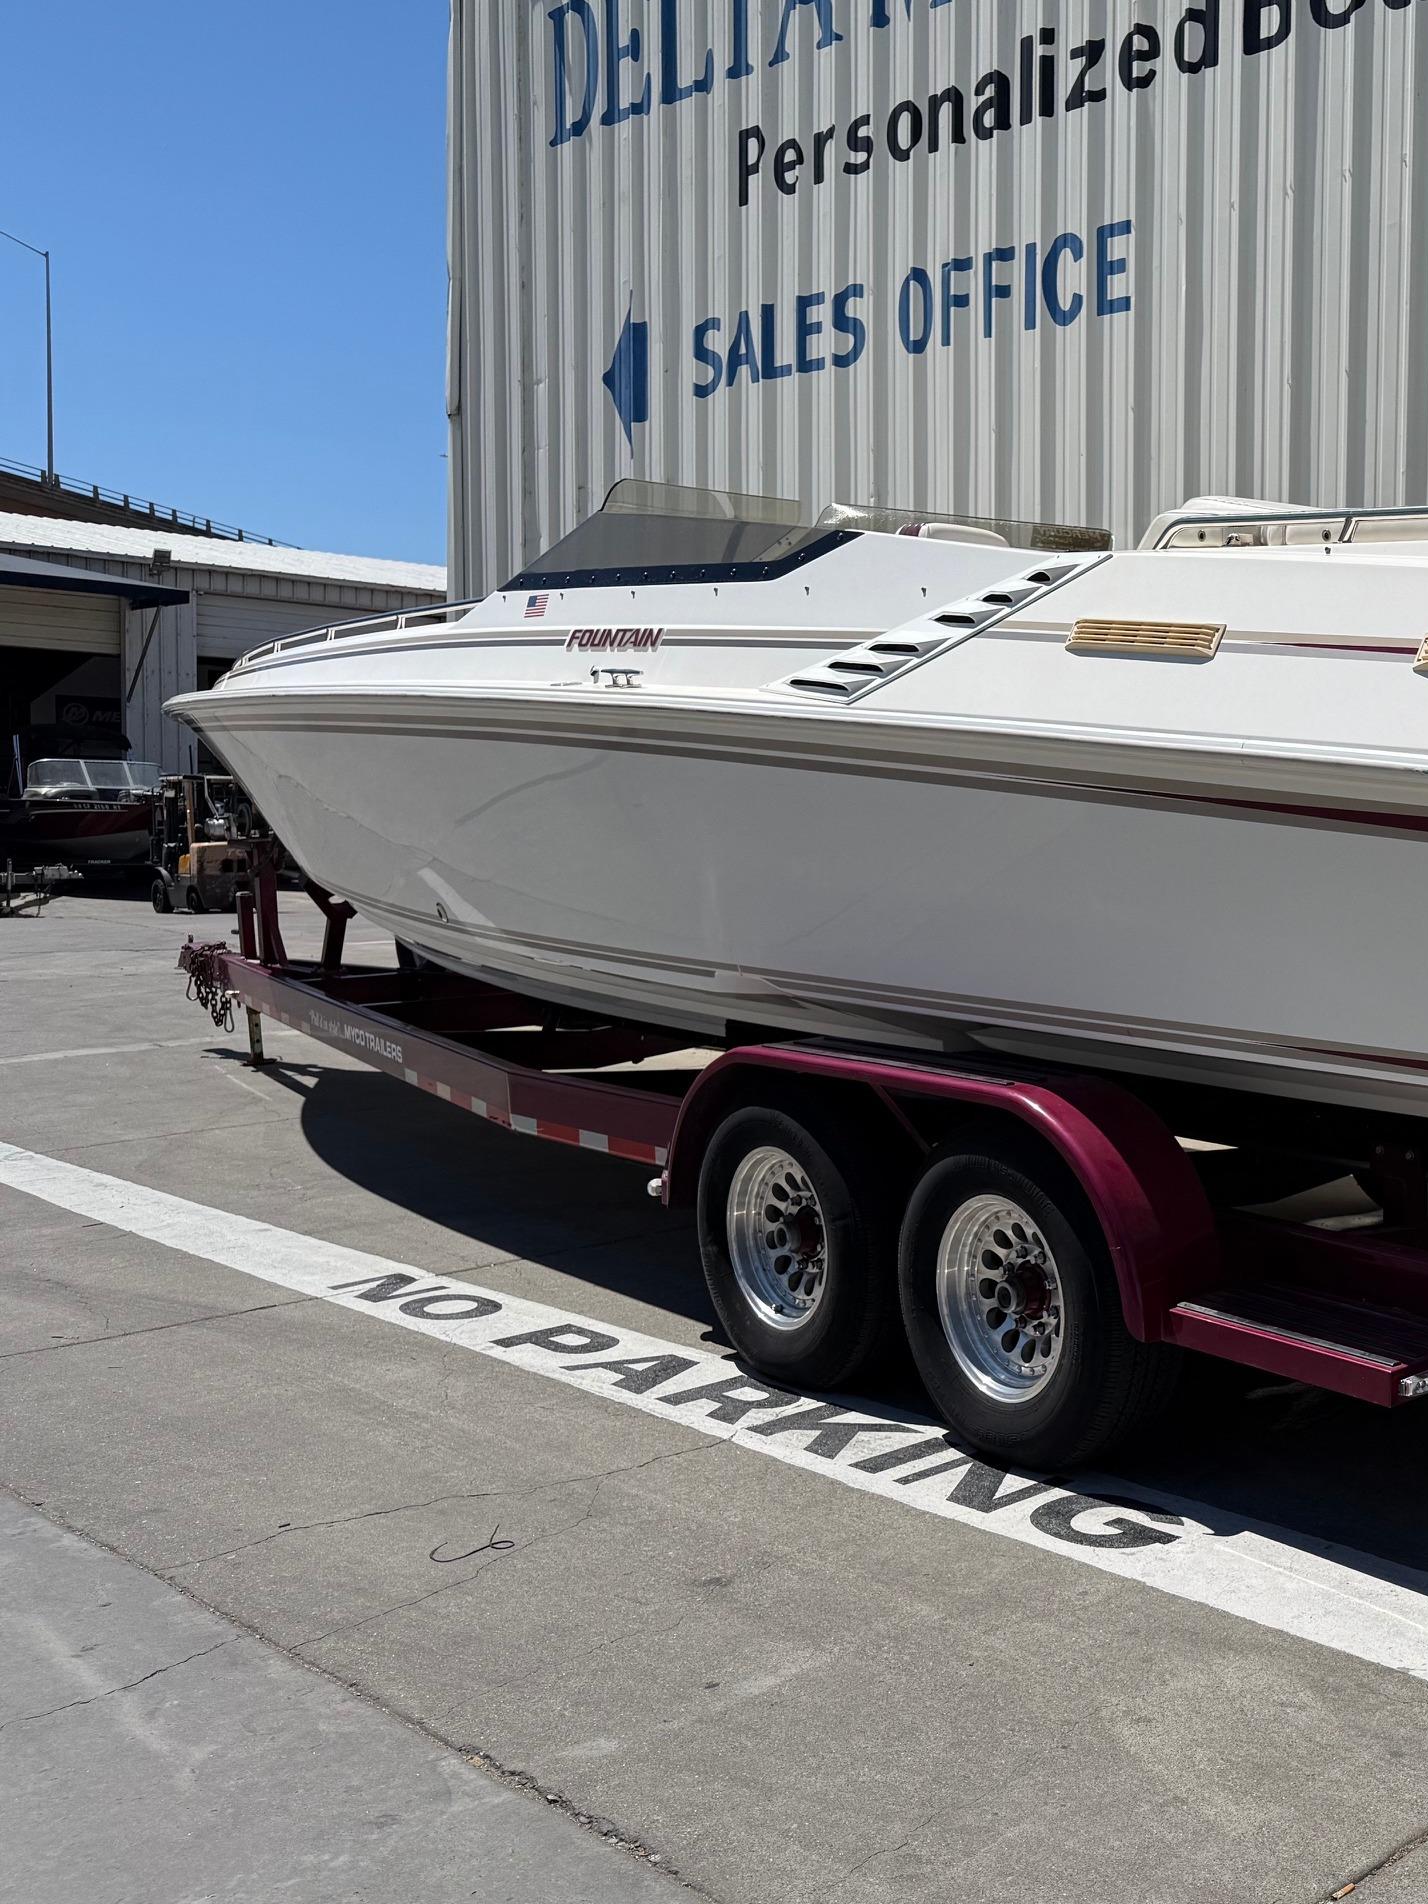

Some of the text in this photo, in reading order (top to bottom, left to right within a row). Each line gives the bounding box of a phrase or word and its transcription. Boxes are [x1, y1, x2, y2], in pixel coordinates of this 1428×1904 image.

[738, 0, 1219, 207] Personalized
[693, 219, 1132, 399] SALES OFFICE
[565, 627, 666, 650] FOUNTAIN
[344, 1023, 403, 1063] MYCO TRAILERS
[327, 1272, 1185, 1550] NO PARKING
